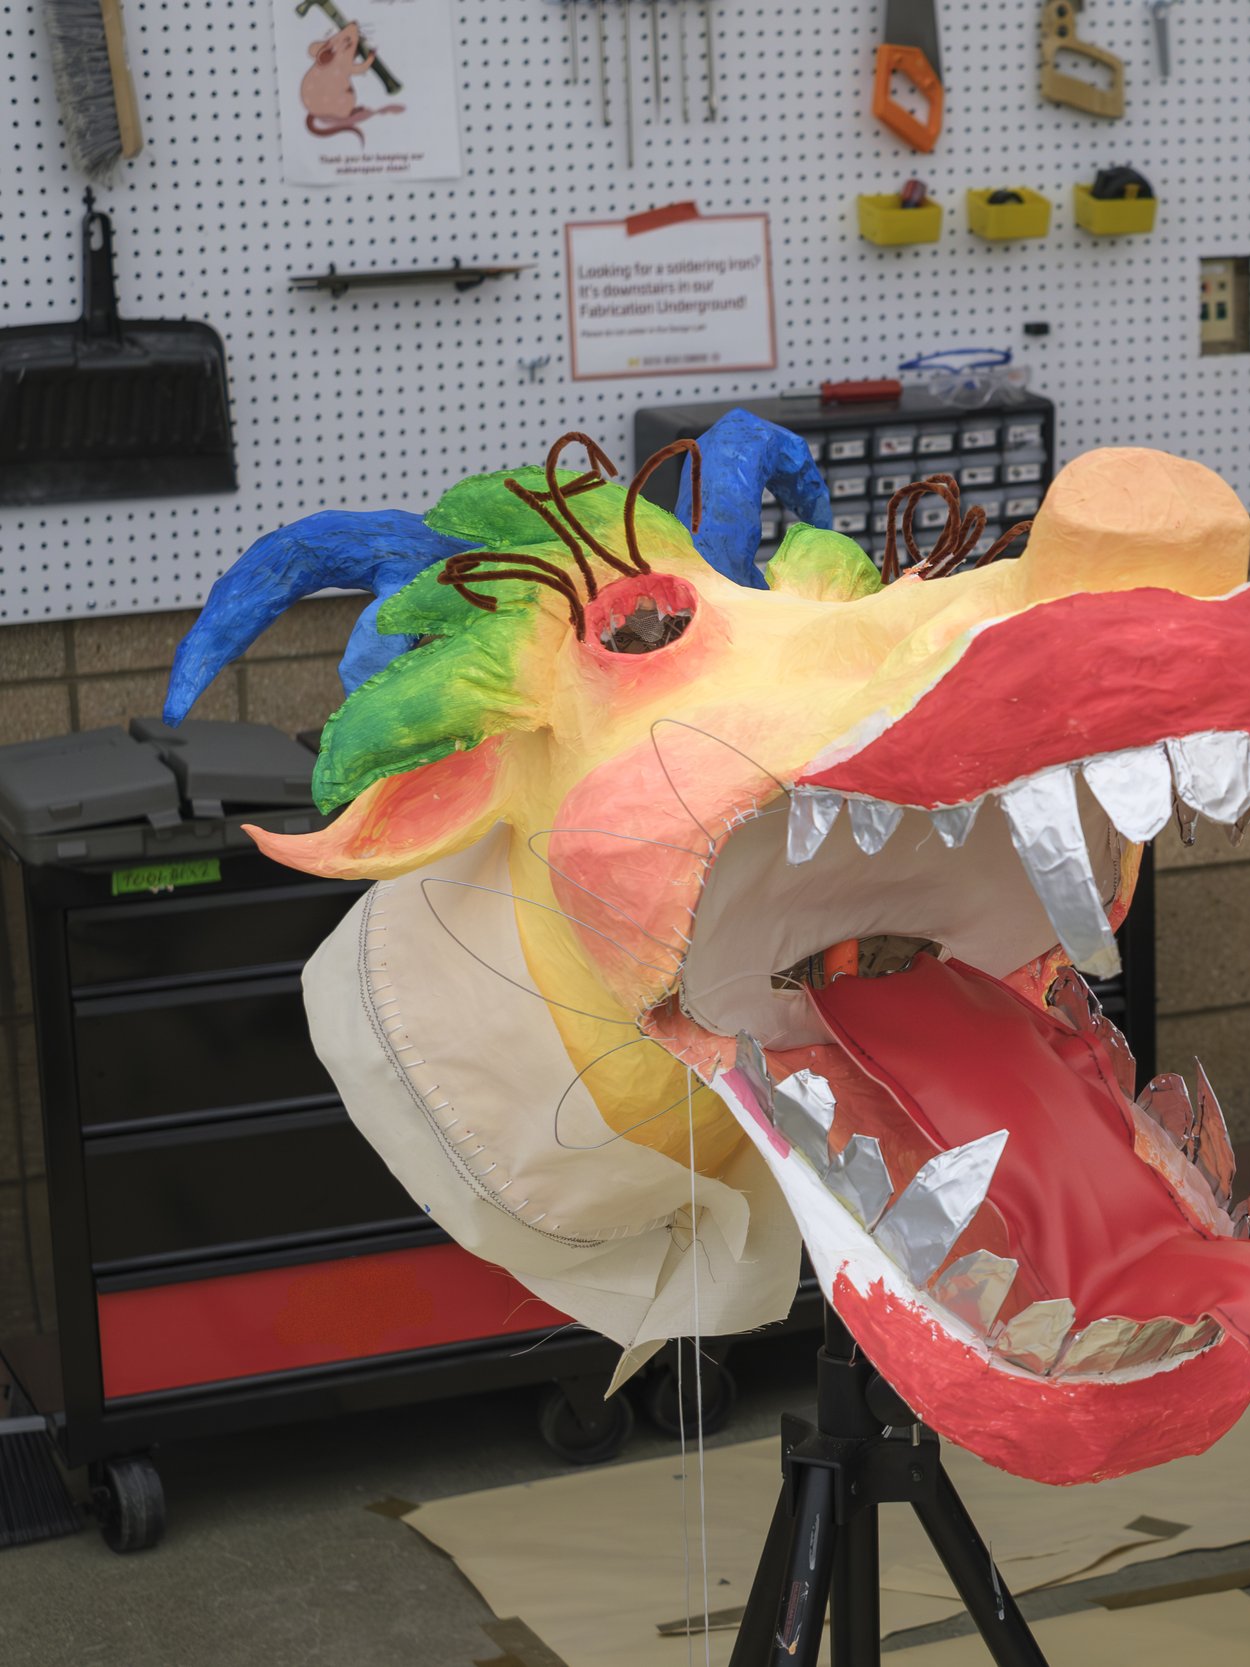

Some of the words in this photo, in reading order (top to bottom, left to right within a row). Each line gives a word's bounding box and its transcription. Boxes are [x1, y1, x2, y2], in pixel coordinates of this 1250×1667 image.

[578, 263, 631, 279] Looking
[634, 261, 653, 275] for
[656, 264, 665, 274] a
[667, 256, 726, 275] soldering
[729, 254, 761, 270] iron?
[579, 284, 599, 298] It's
[603, 280, 674, 297] downstairs
[678, 280, 690, 294] in
[693, 280, 714, 292] our
[580, 301, 653, 318] Fabrication
[656, 296, 747, 315] Underground!
